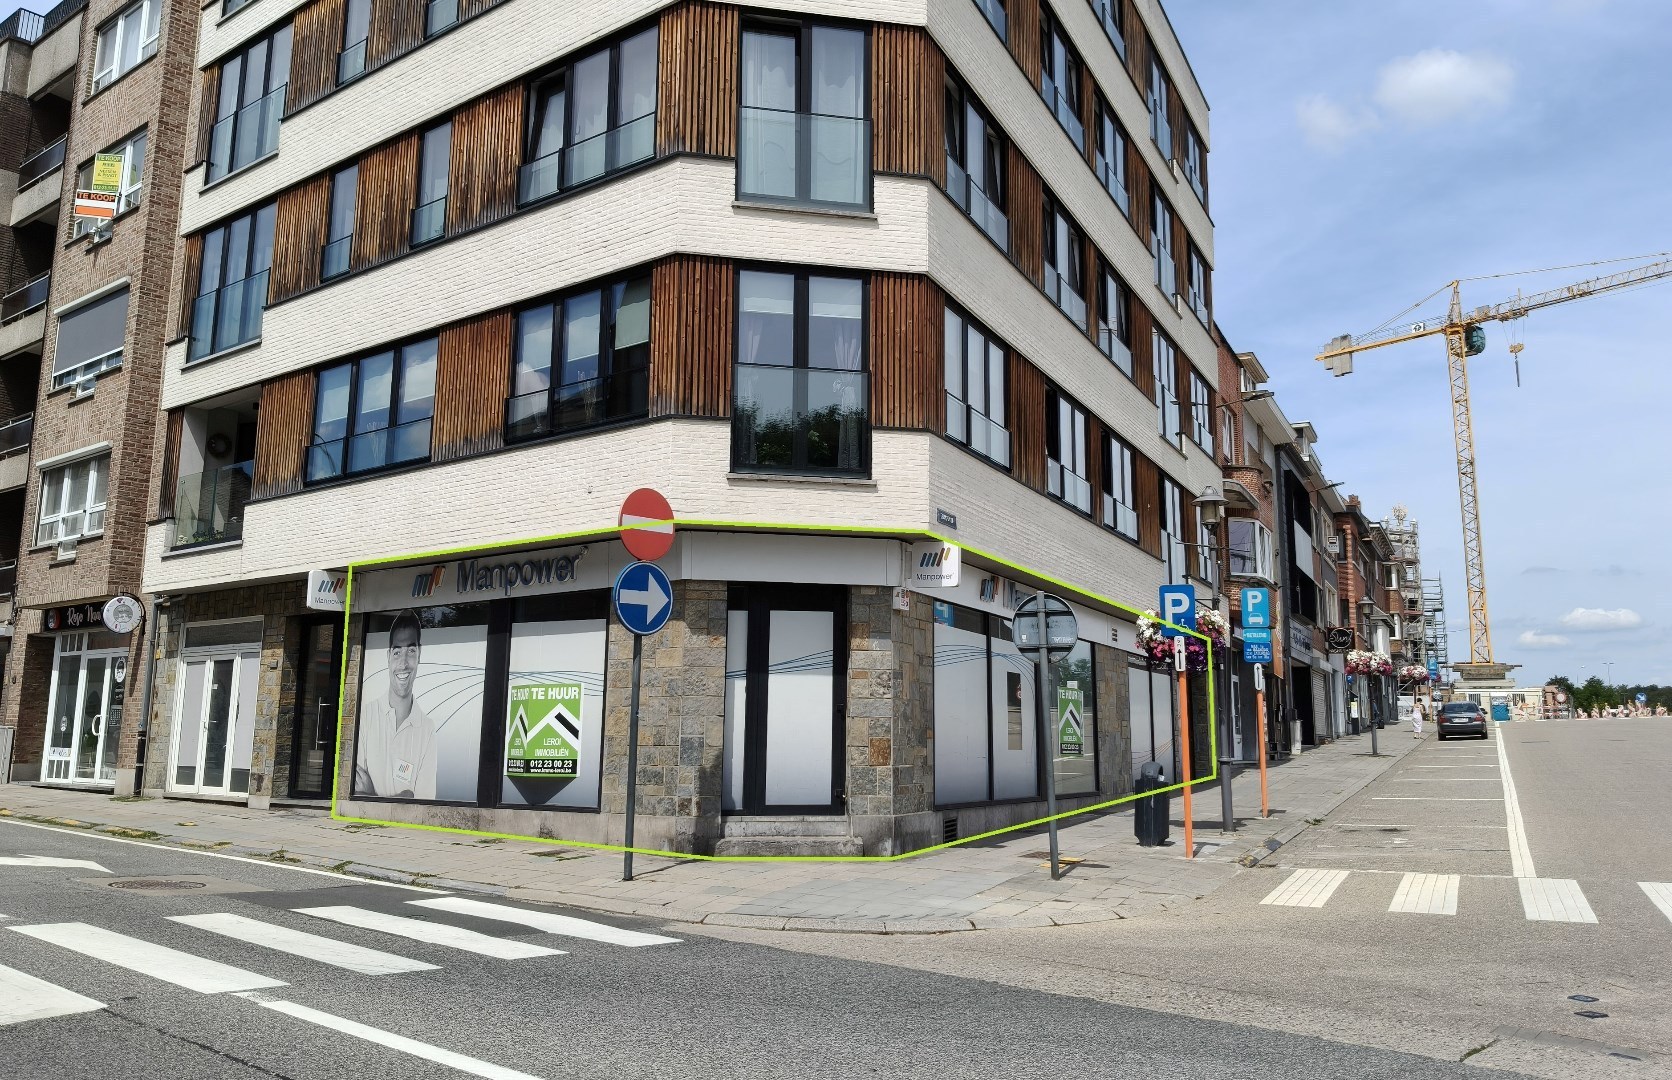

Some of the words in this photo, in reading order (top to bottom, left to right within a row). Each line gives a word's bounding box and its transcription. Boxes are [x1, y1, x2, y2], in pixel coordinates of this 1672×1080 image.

[90, 193, 116, 202] KOOP
[916, 573, 952, 582] Manpower
[1247, 590, 1262, 612] P
[1164, 592, 1190, 628] P
[531, 687, 546, 700] TE
[547, 687, 580, 700] HUUR
[530, 760, 543, 768] 012
[543, 760, 553, 768] 23
[553, 760, 563, 768] 00
[563, 760, 573, 768] 23
